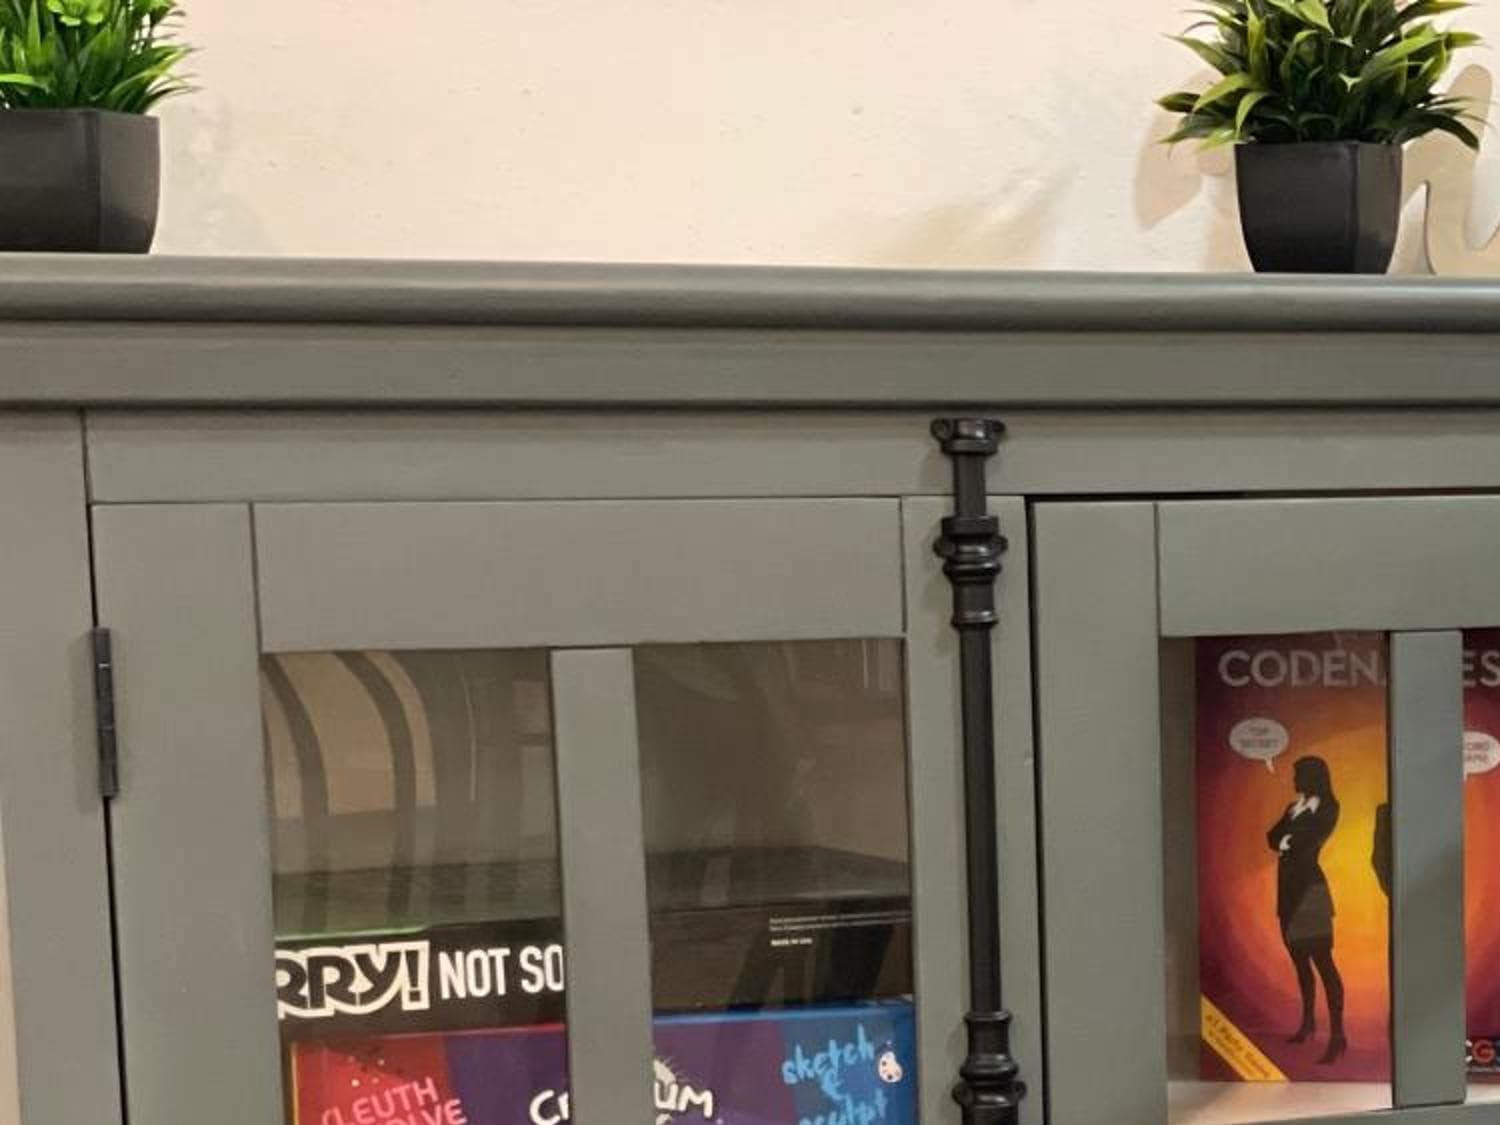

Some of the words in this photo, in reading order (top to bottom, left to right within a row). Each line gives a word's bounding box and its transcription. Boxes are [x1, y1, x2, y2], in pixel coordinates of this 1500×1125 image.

[275, 941, 430, 1019] RRY!
[439, 948, 510, 999] NOT
[519, 944, 565, 993] SO
[781, 1022, 875, 1084] sketch
